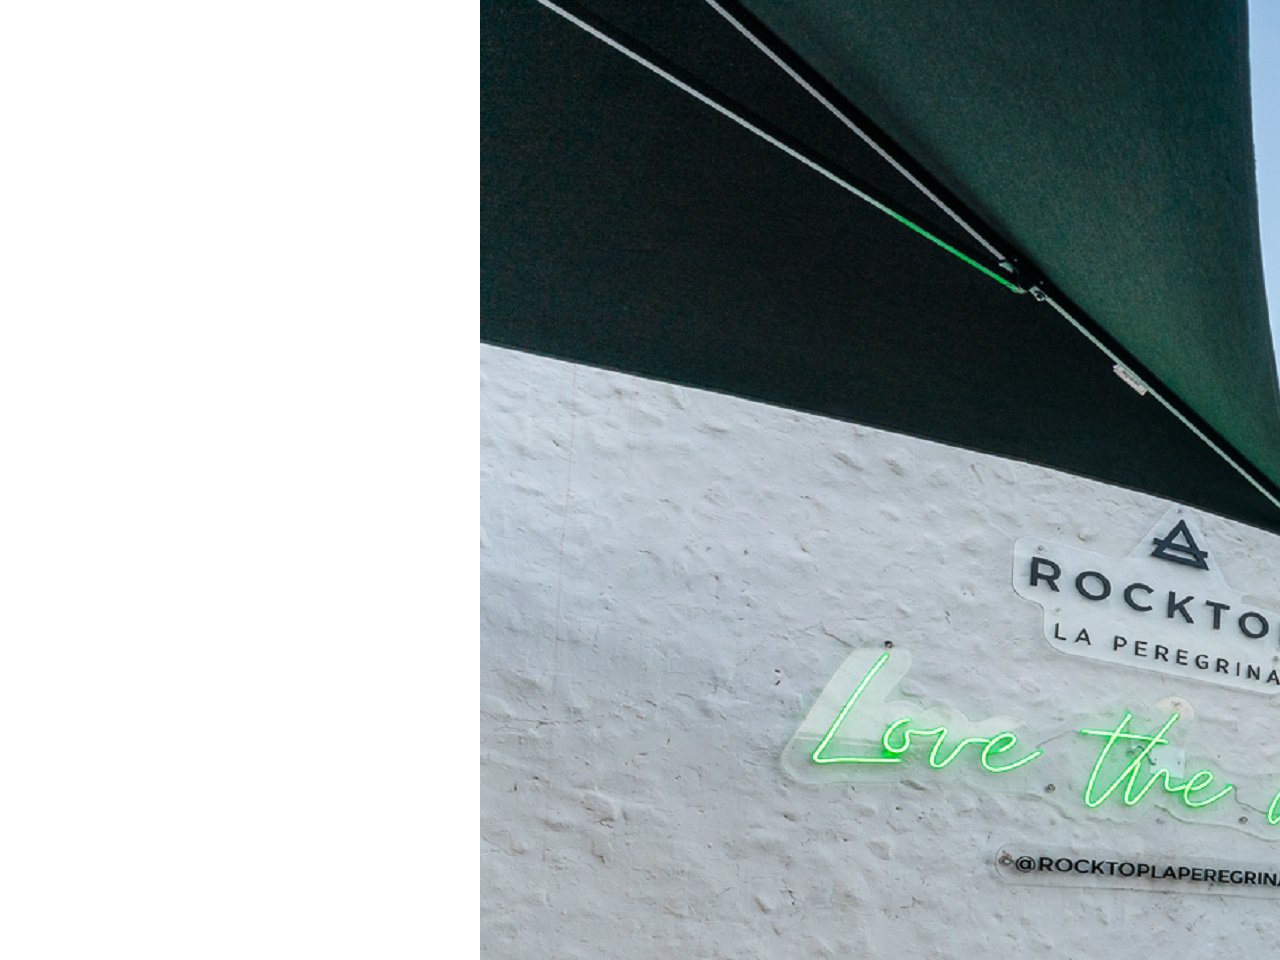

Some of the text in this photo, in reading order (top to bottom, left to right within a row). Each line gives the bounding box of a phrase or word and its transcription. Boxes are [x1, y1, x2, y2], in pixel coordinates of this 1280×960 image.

[1053, 622, 1280, 686] LA PEREGRINA
[811, 652, 1043, 773] Love
[1078, 713, 1233, 808] the
